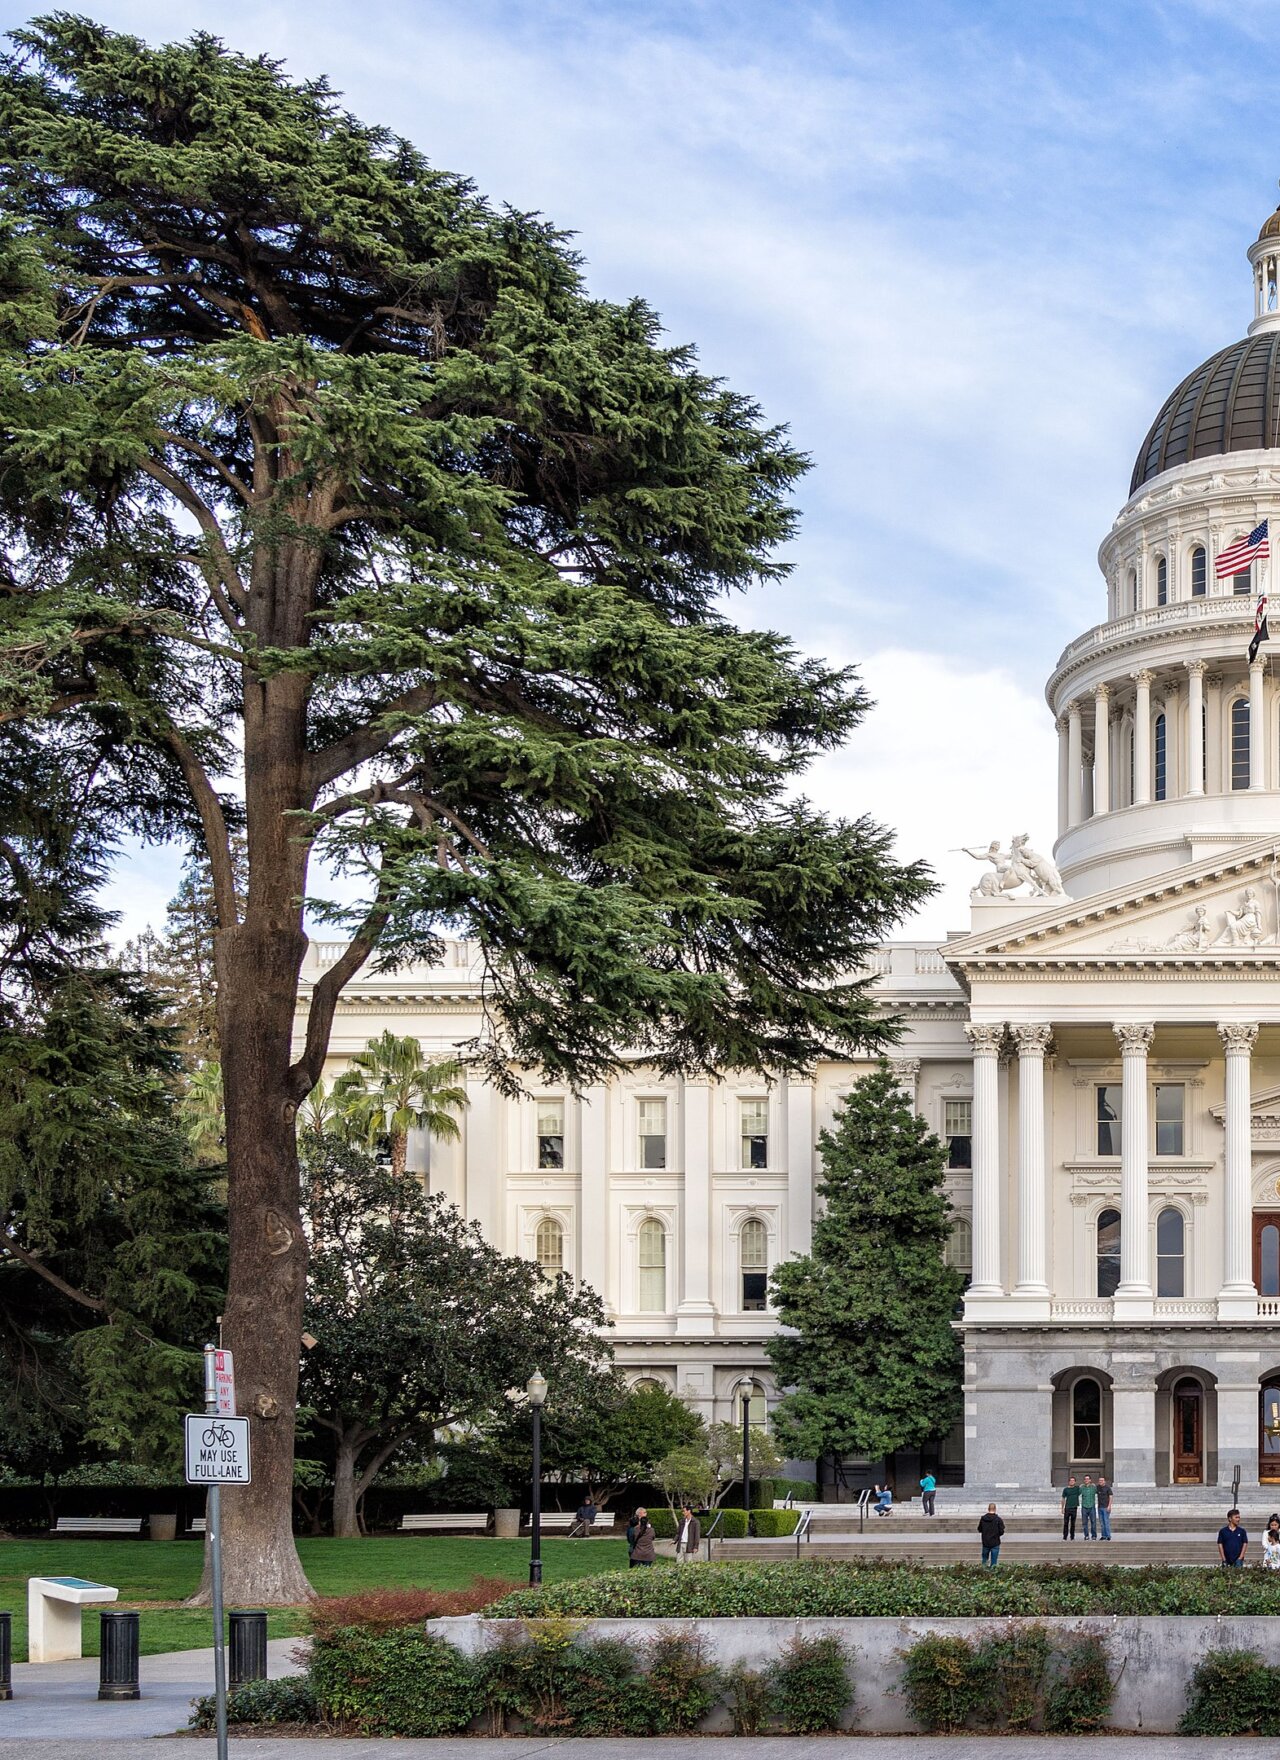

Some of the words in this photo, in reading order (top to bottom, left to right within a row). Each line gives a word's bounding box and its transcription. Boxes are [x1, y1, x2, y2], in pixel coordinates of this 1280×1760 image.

[216, 1373, 232, 1383] PARKING
[220, 1386, 229, 1396] ANY
[220, 1399, 230, 1410] TIME
[200, 1449, 217, 1462] MAY
[220, 1450, 238, 1462] USE
